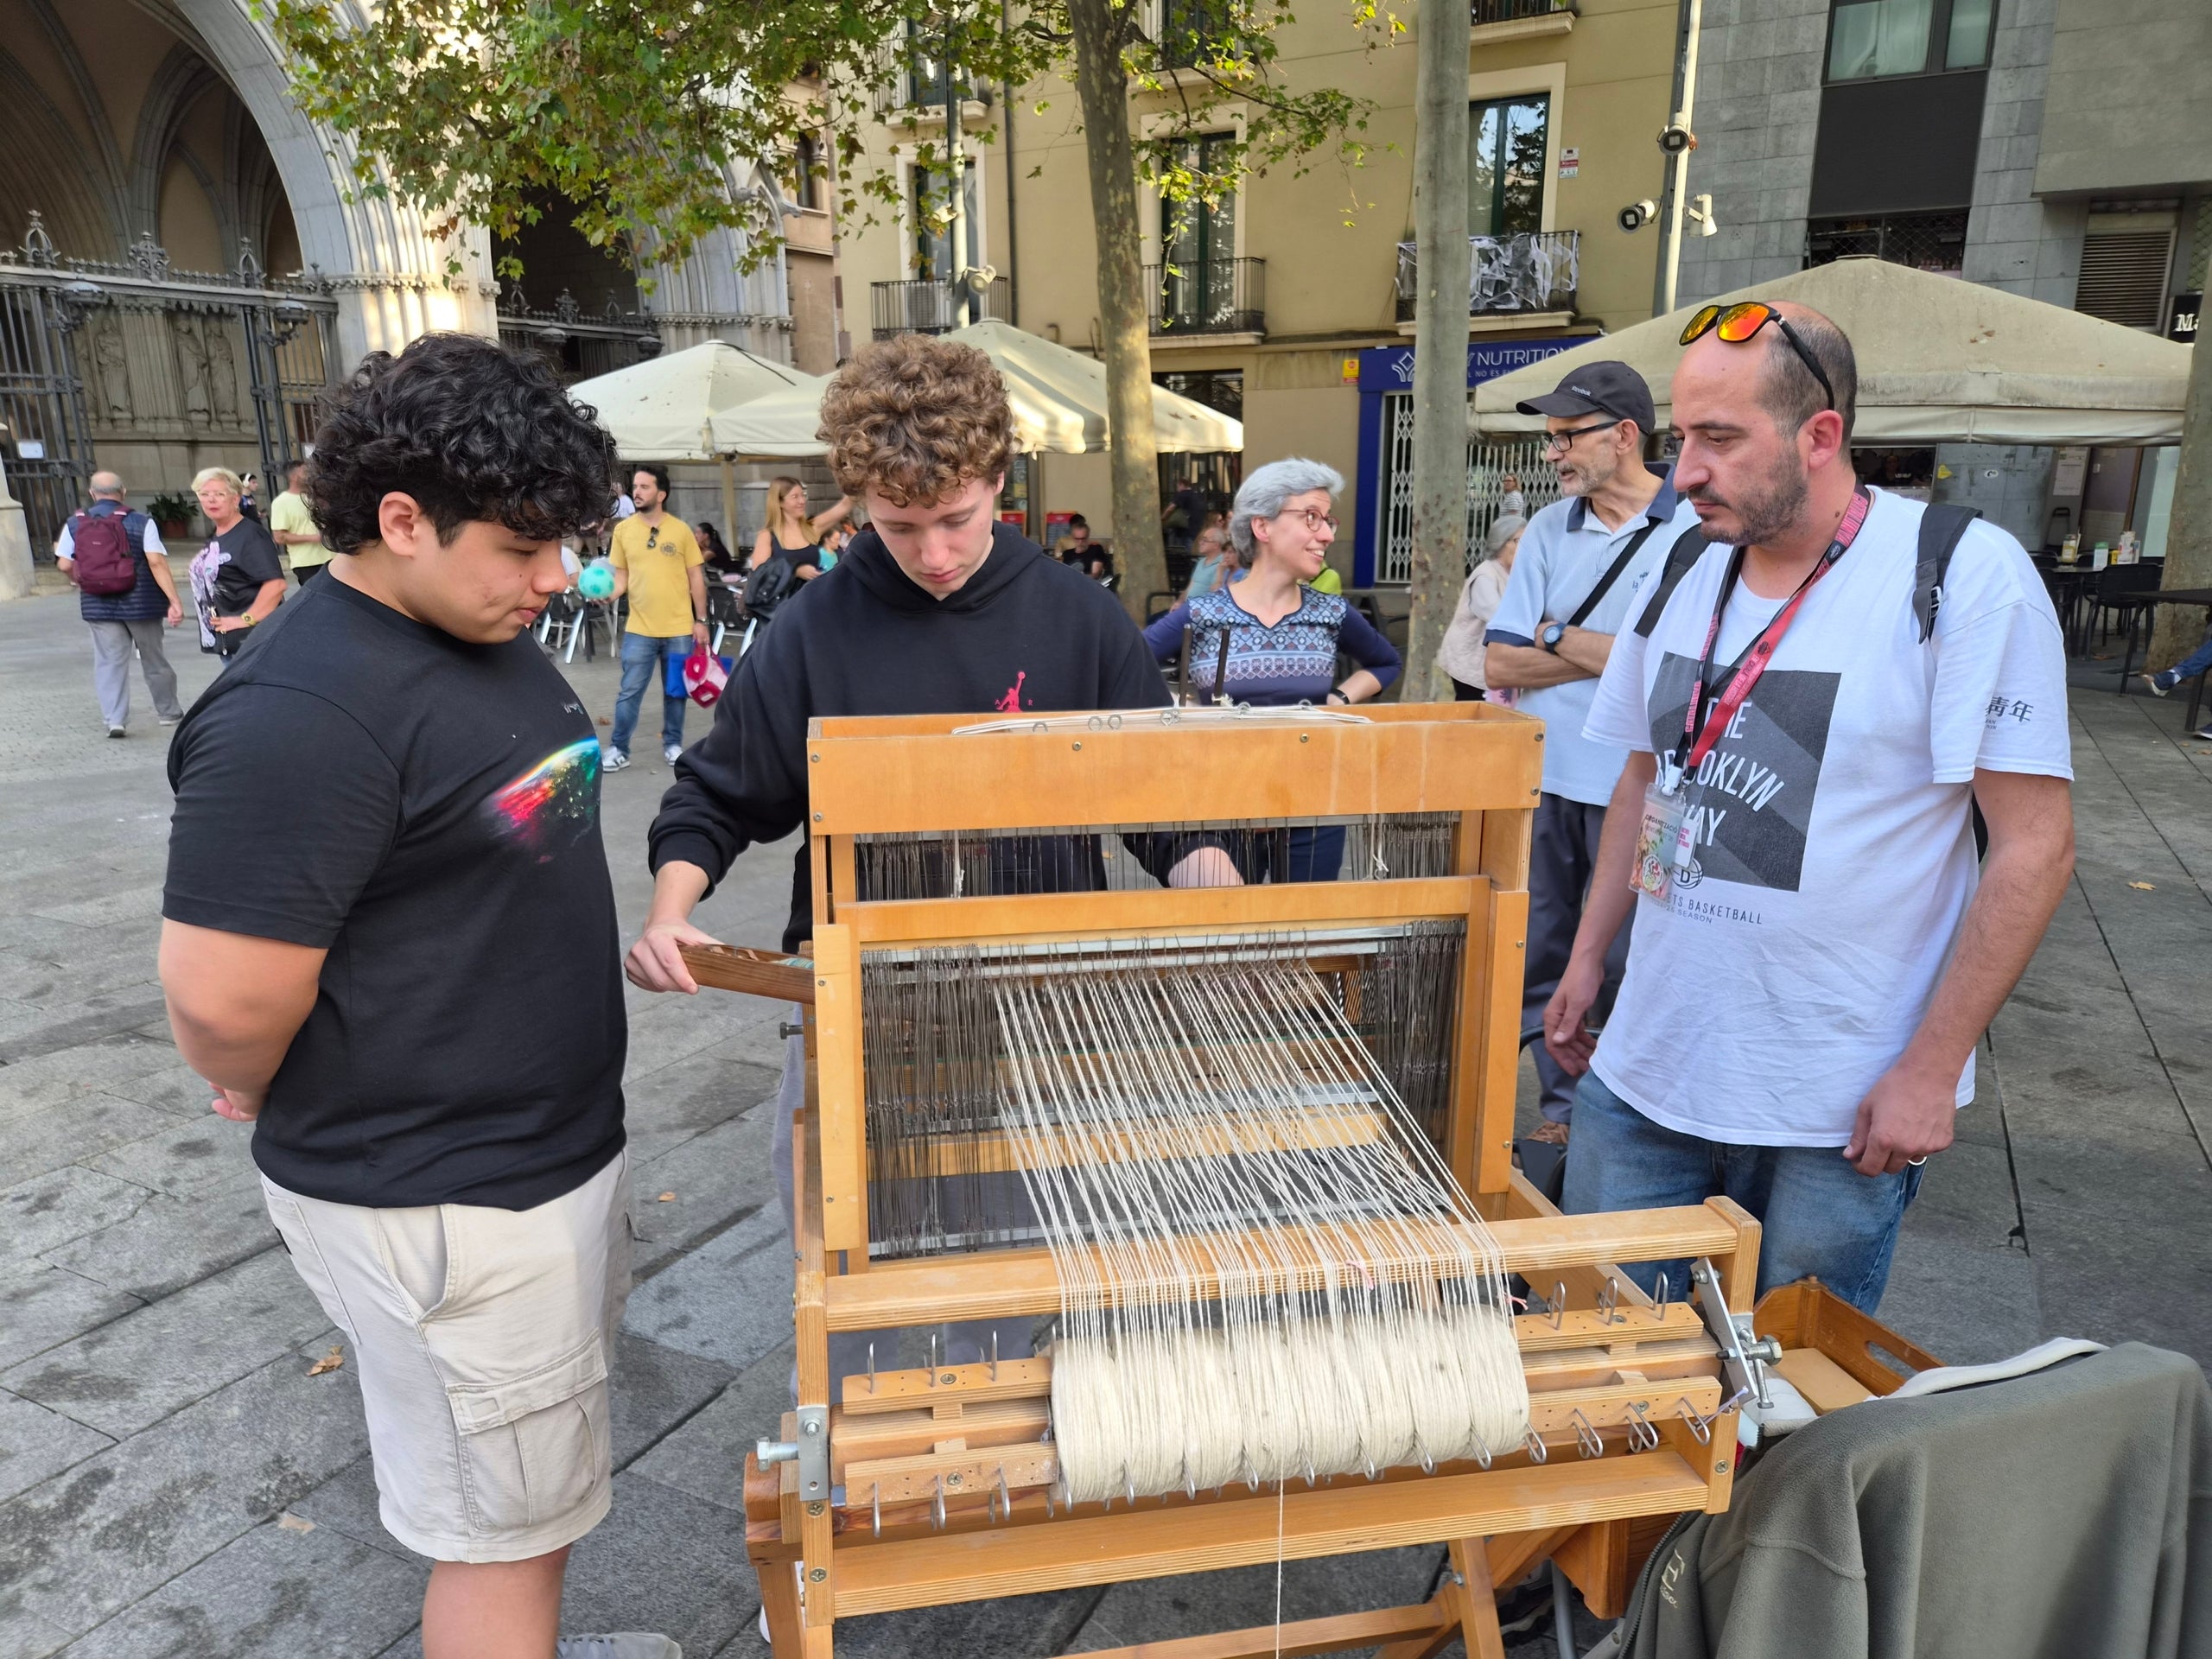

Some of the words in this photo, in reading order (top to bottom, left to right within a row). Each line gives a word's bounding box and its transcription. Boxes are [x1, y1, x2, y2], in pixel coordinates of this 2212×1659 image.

[1704, 697, 1752, 739] TE
[1655, 749, 1785, 812] BROKLYN
[1662, 893, 1684, 907] ETS
[1688, 899, 1763, 925] BASKETBALL
[1677, 909, 1713, 924] SEASON
